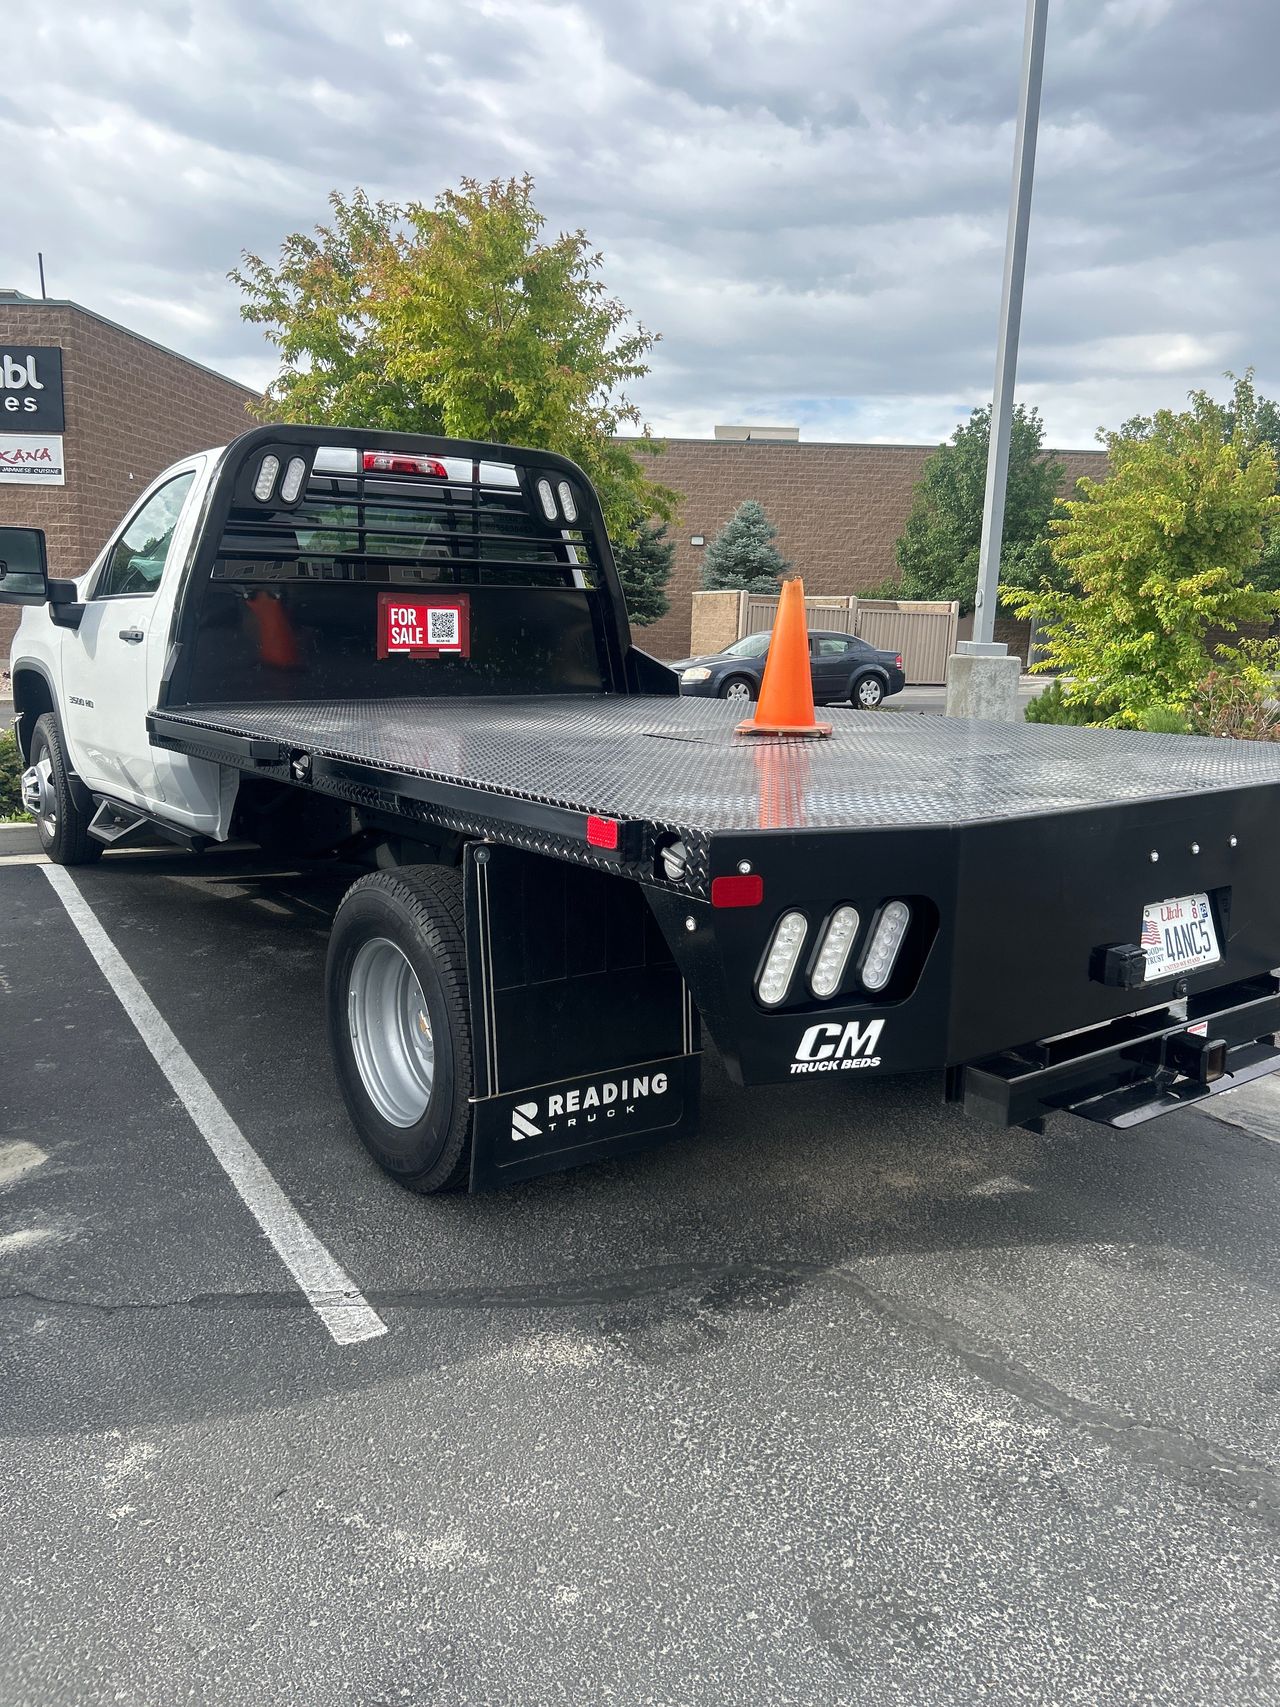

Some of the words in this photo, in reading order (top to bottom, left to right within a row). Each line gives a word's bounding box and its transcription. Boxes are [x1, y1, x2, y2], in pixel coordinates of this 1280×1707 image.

[391, 608, 417, 626] FOR
[391, 627, 423, 644] SALE
[1161, 903, 1183, 922] Utah
[1191, 907, 1198, 919] 8
[1165, 919, 1211, 962] 4ANC5
[1146, 953, 1164, 965] TRUST
[795, 1019, 885, 1061] CM
[790, 1060, 840, 1074] TRUCK
[841, 1057, 881, 1070] BEDS
[548, 1073, 668, 1117] READING
[548, 1105, 635, 1131] TRUCK
